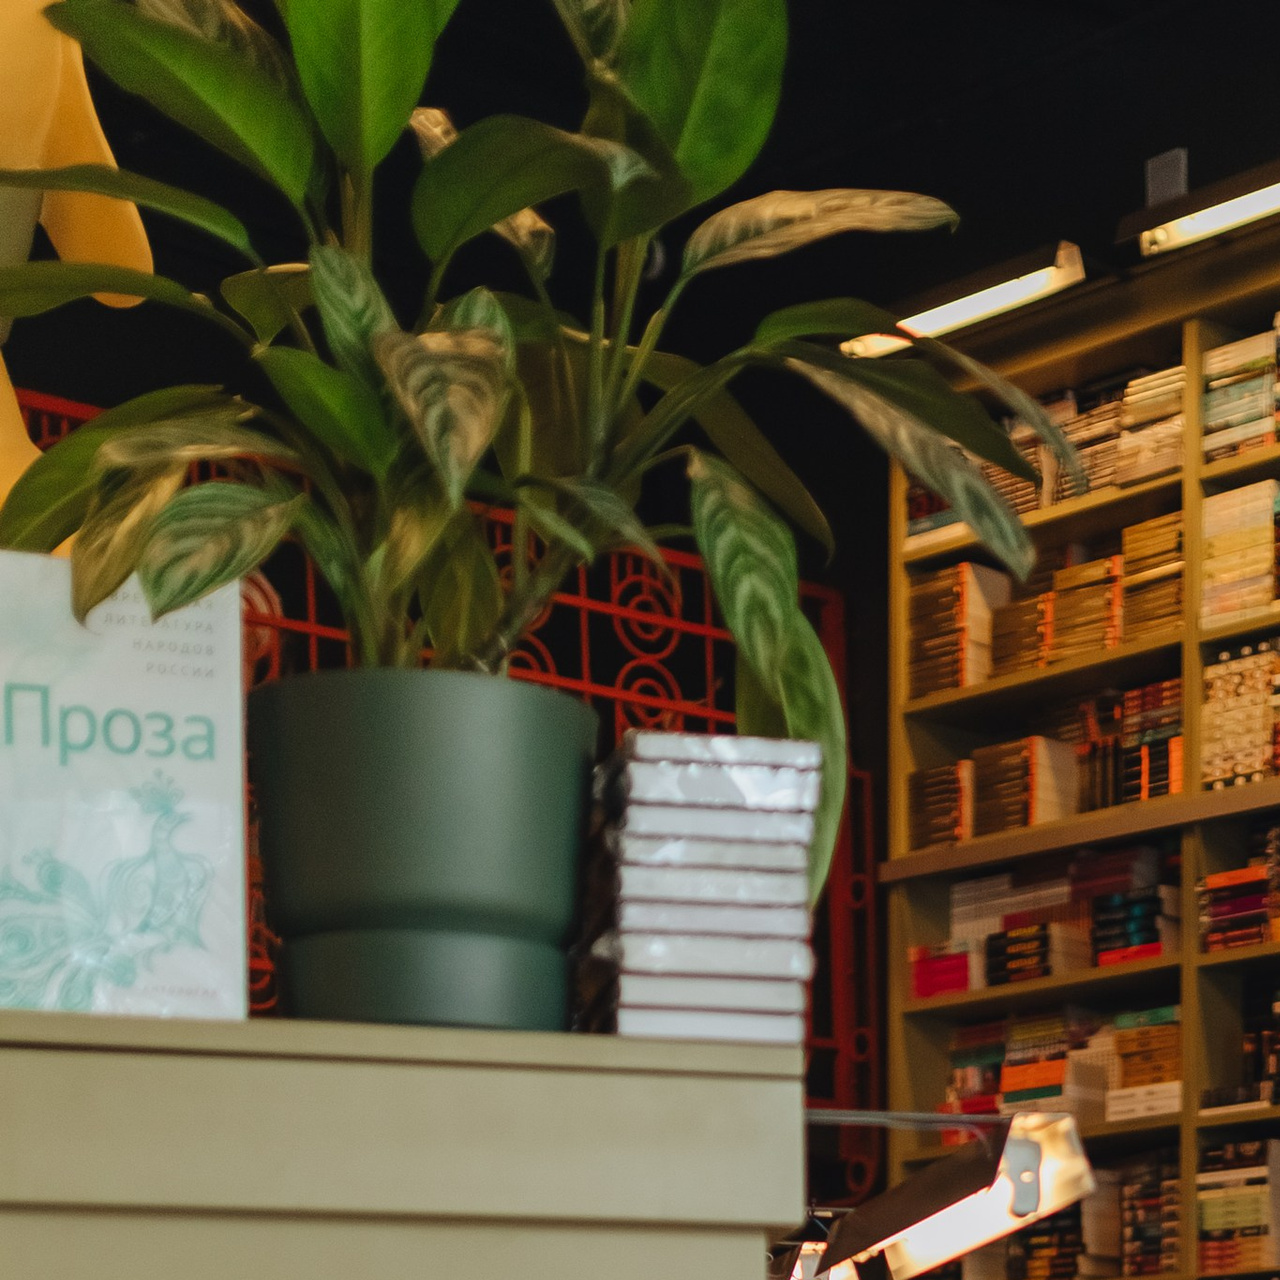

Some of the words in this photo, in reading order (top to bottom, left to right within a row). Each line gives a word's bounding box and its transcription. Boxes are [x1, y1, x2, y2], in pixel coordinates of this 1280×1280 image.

[103, 612, 215, 635] ЛИТЕАТУРА
[132, 639, 215, 656] НАРОДОВ
[145, 662, 215, 679] РОССИИ
[2, 683, 218, 768] Проза
